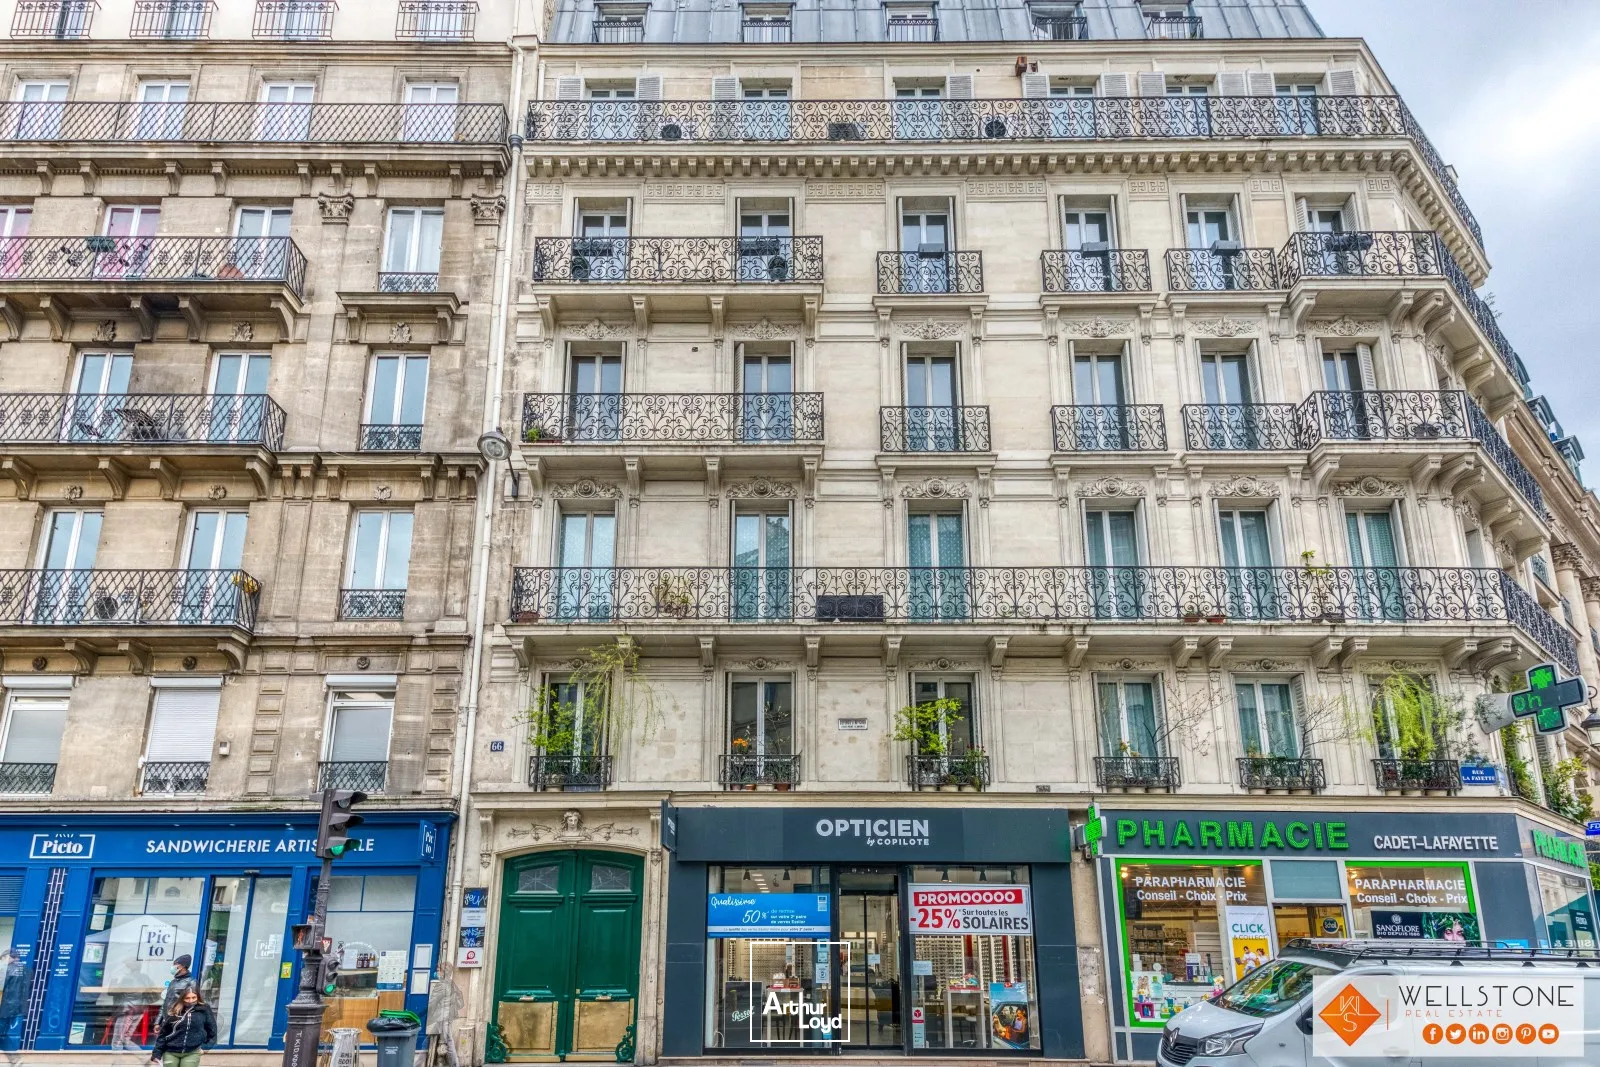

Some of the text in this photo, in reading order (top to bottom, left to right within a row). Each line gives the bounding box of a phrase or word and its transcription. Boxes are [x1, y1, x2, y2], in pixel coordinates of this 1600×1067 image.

[492, 741, 502, 750] 66
[816, 819, 929, 837] OPTICIEN
[1116, 819, 1349, 849] PHARMACIE
[41, 840, 83, 854] Picto
[146, 839, 374, 853] SANDWICHERIE ARTISLE
[866, 837, 875, 846] by
[1373, 835, 1498, 850] CADET-LAFAYETTE
[1135, 876, 1246, 888] PARAPHARMACIE
[1355, 879, 1466, 890] PARAPHARMACIE
[918, 891, 1015, 904] PROMOOOOO
[1136, 890, 1177, 901] Conseil
[1185, 890, 1216, 901] Choix
[1226, 890, 1247, 901] Prix
[1357, 893, 1397, 904] Conseil
[1405, 893, 1437, 904] Choix
[1446, 893, 1468, 904] Prix
[963, 917, 1029, 930] SOLAIRES
[1232, 923, 1263, 933] CLICK
[1376, 924, 1420, 933] SANOFLORE
[147, 930, 171, 943] Pic
[149, 945, 164, 956] to
